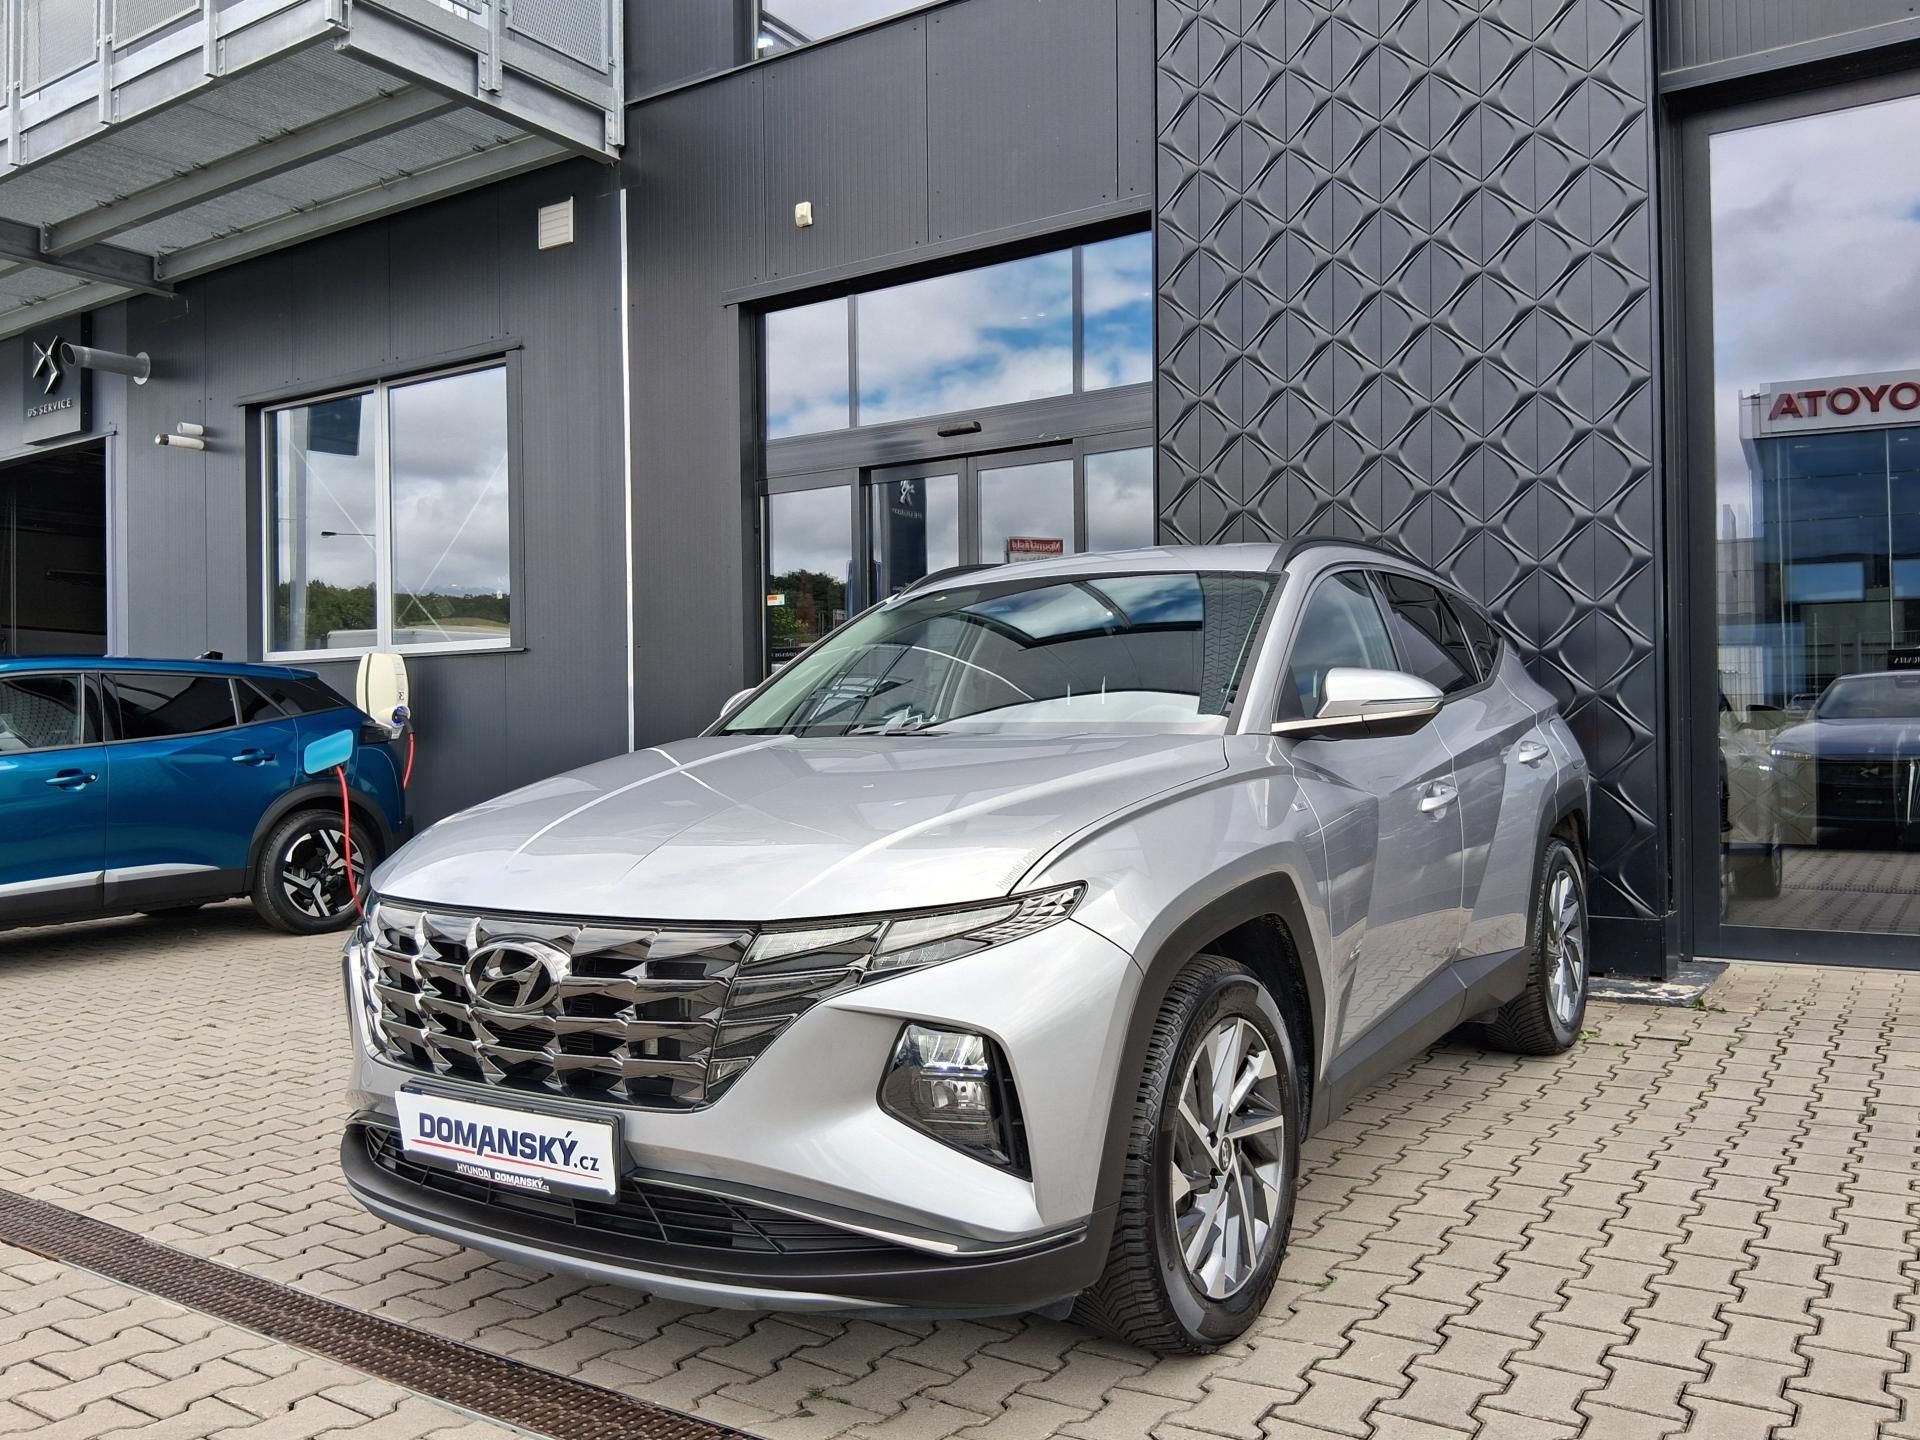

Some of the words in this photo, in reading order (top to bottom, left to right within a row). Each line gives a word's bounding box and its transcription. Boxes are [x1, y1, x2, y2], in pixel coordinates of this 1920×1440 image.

[27, 407, 37, 417] DS
[38, 397, 71, 415] SERVICE
[456, 1162, 491, 1179] HYUNDAI
